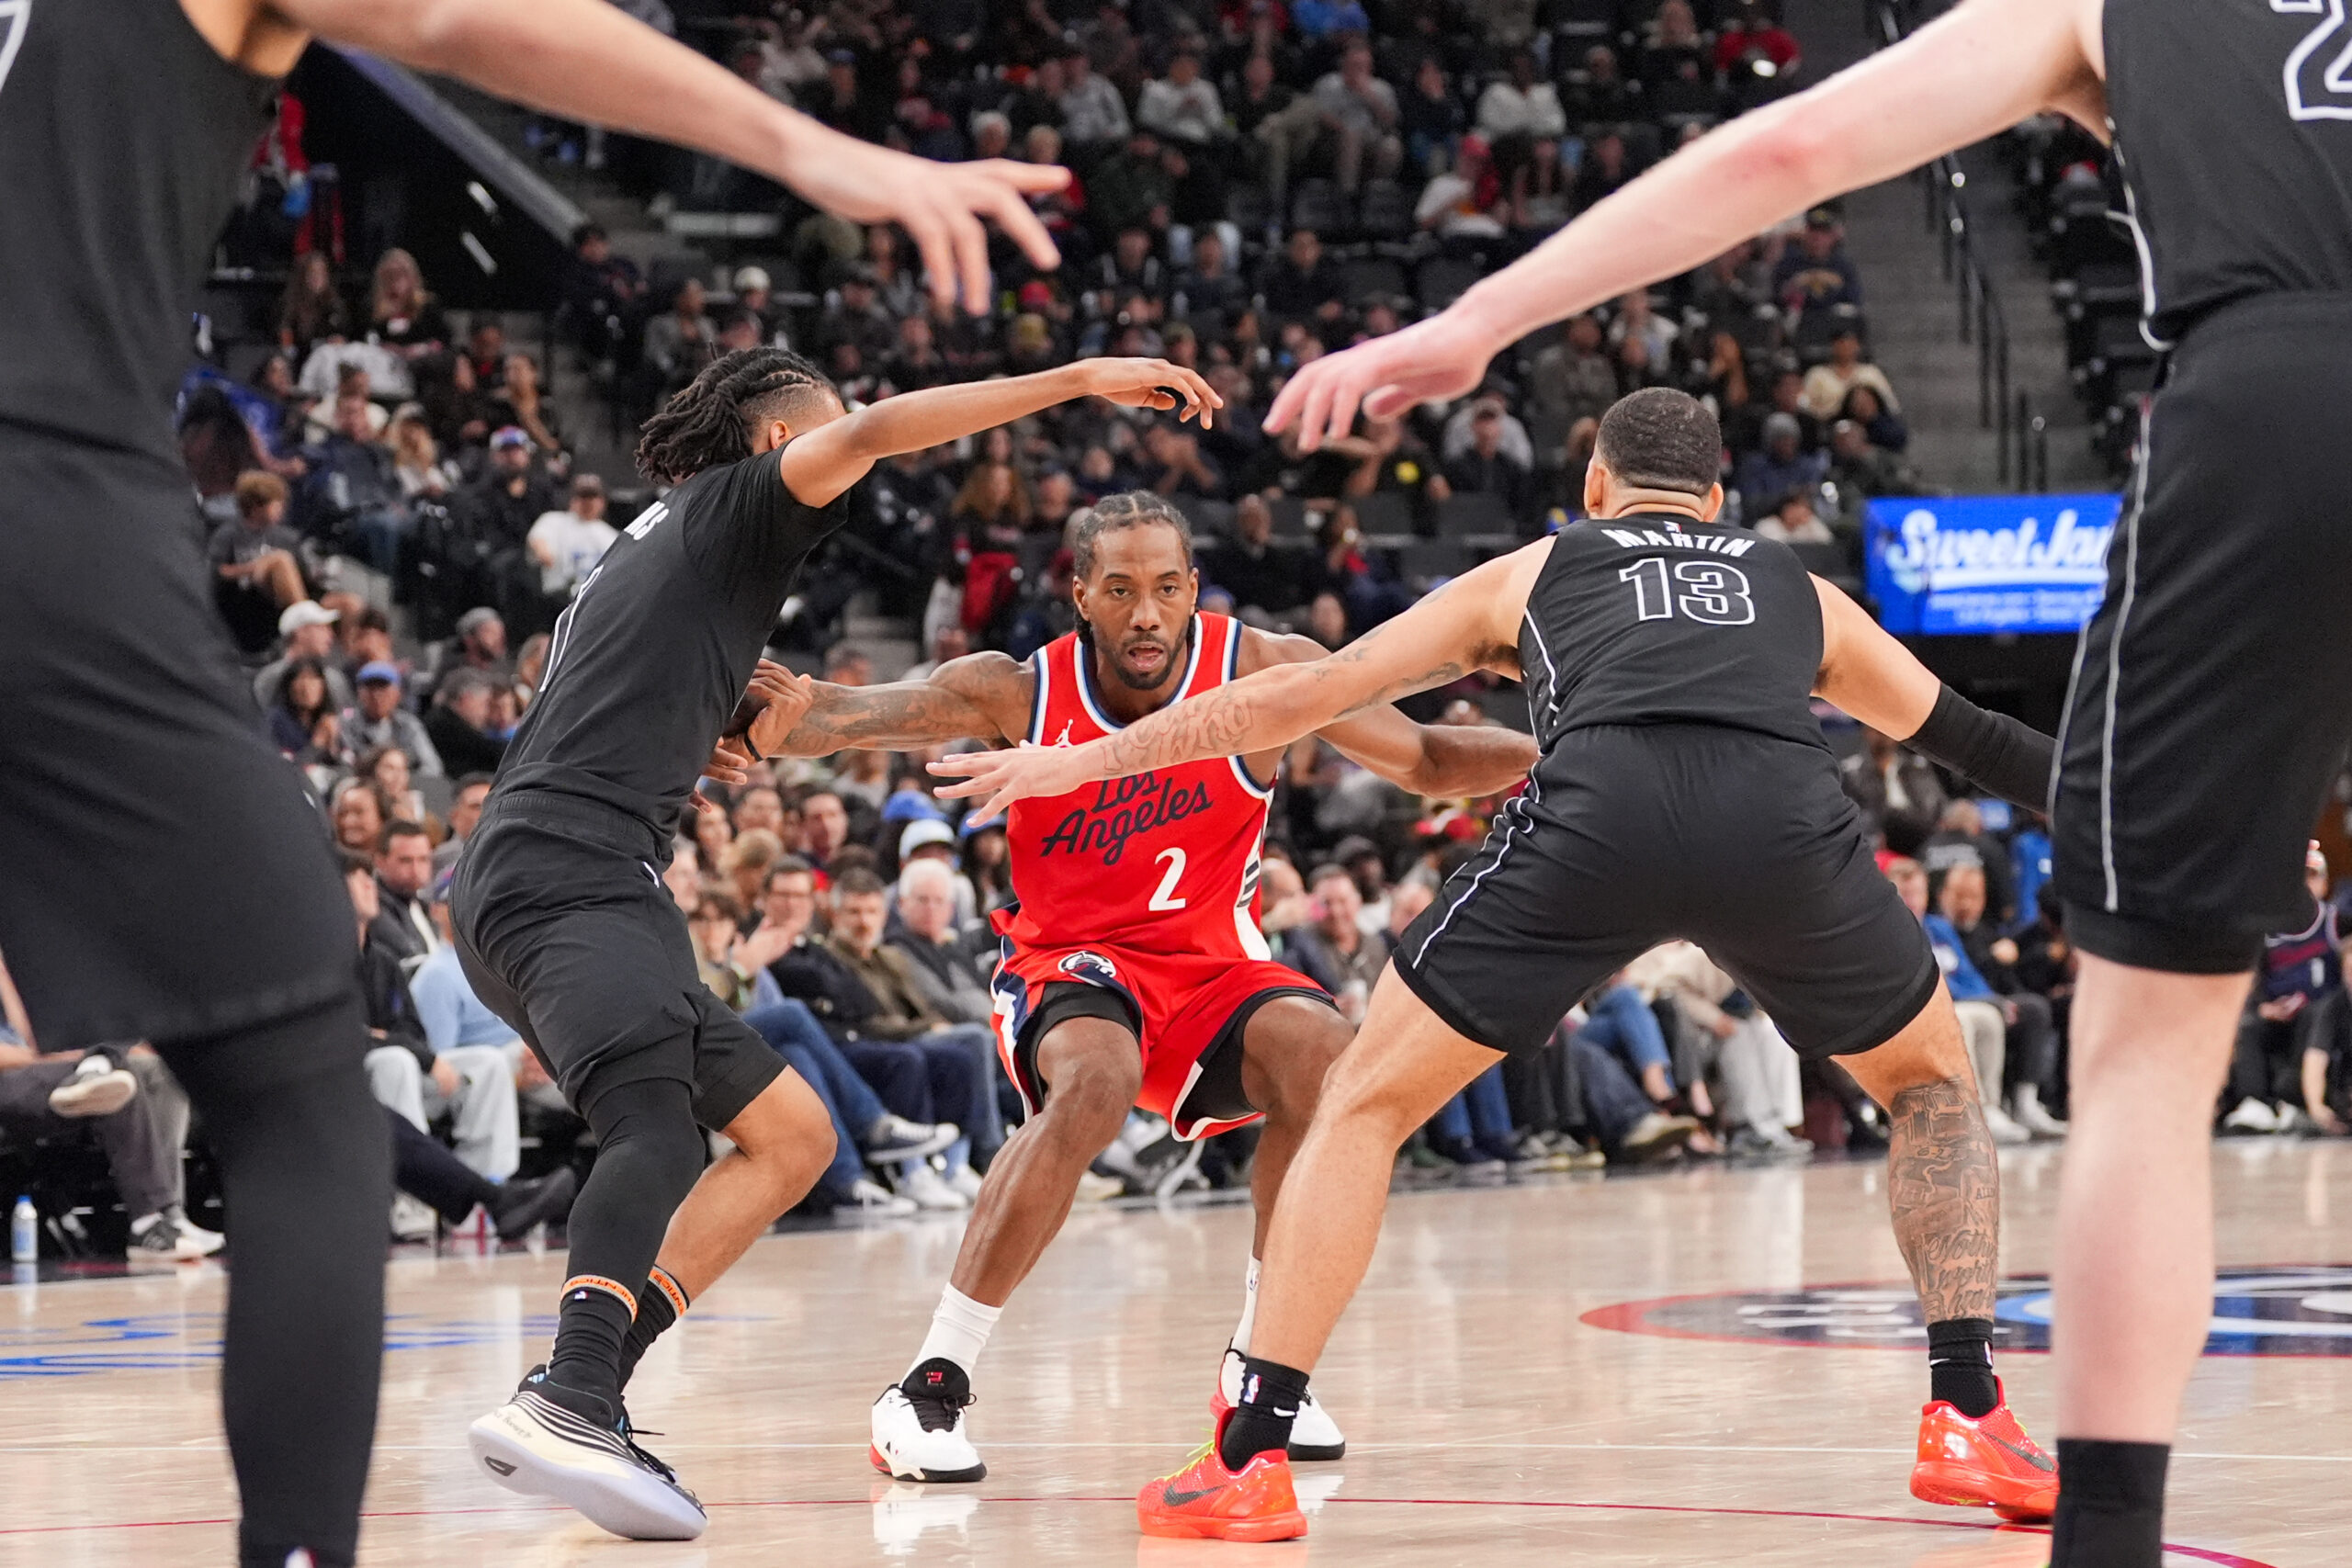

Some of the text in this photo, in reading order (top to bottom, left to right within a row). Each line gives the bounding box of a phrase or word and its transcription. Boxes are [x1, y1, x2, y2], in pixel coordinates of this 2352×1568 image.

[1600, 529, 1756, 558] MARTIN
[1618, 558, 1756, 626] 13
[1040, 777, 1214, 865] Angeles
[1091, 771, 1160, 814] Los
[1148, 847, 1187, 911] 2
